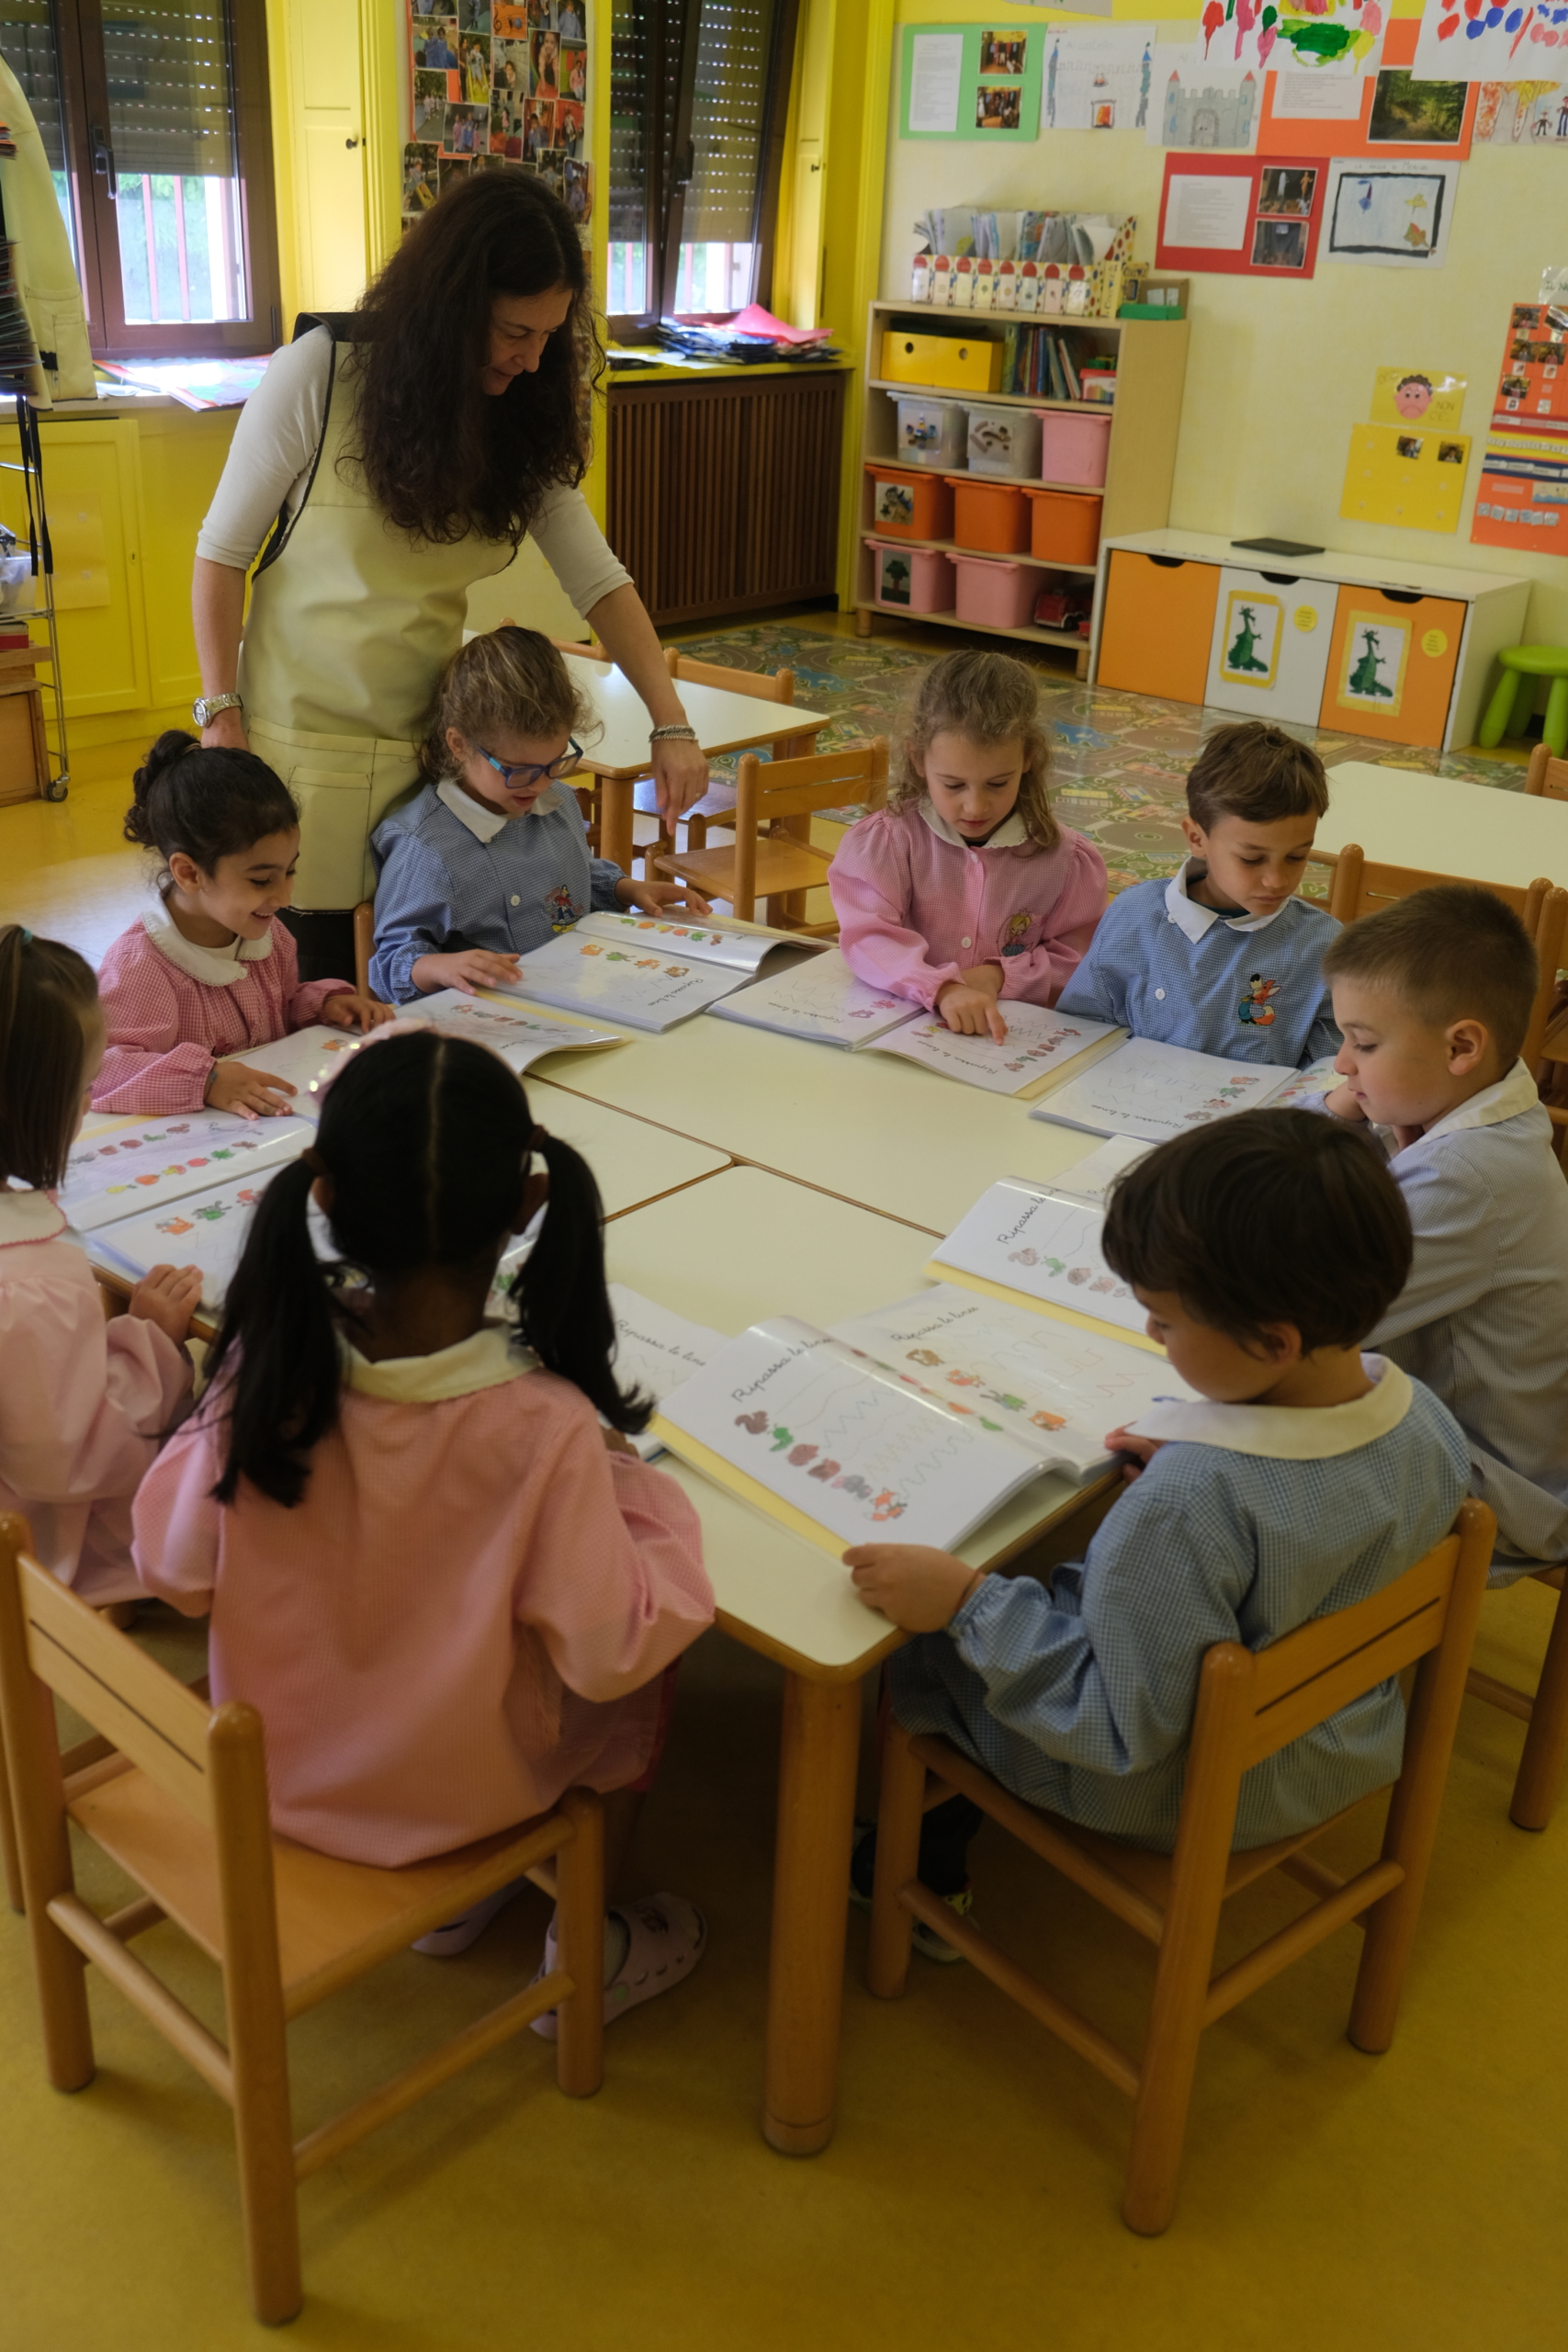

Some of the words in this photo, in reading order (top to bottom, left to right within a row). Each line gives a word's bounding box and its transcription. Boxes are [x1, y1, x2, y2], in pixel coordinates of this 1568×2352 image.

[1436, 401, 1455, 411] NON
[917, 1040, 941, 1052] linee
[953, 1056, 998, 1075] Ripassa
[1090, 1103, 1118, 1115] linee
[1133, 1114, 1185, 1129] Ripassa
[997, 1204, 1038, 1244] Ripassa
[1030, 1196, 1046, 1205] le
[890, 1323, 942, 1342] Ripassa
[947, 1306, 979, 1319] linee
[615, 1319, 664, 1350] Ripassa
[668, 1345, 681, 1356] le
[730, 1357, 792, 1403] Ripassa
[785, 1347, 805, 1357] le
